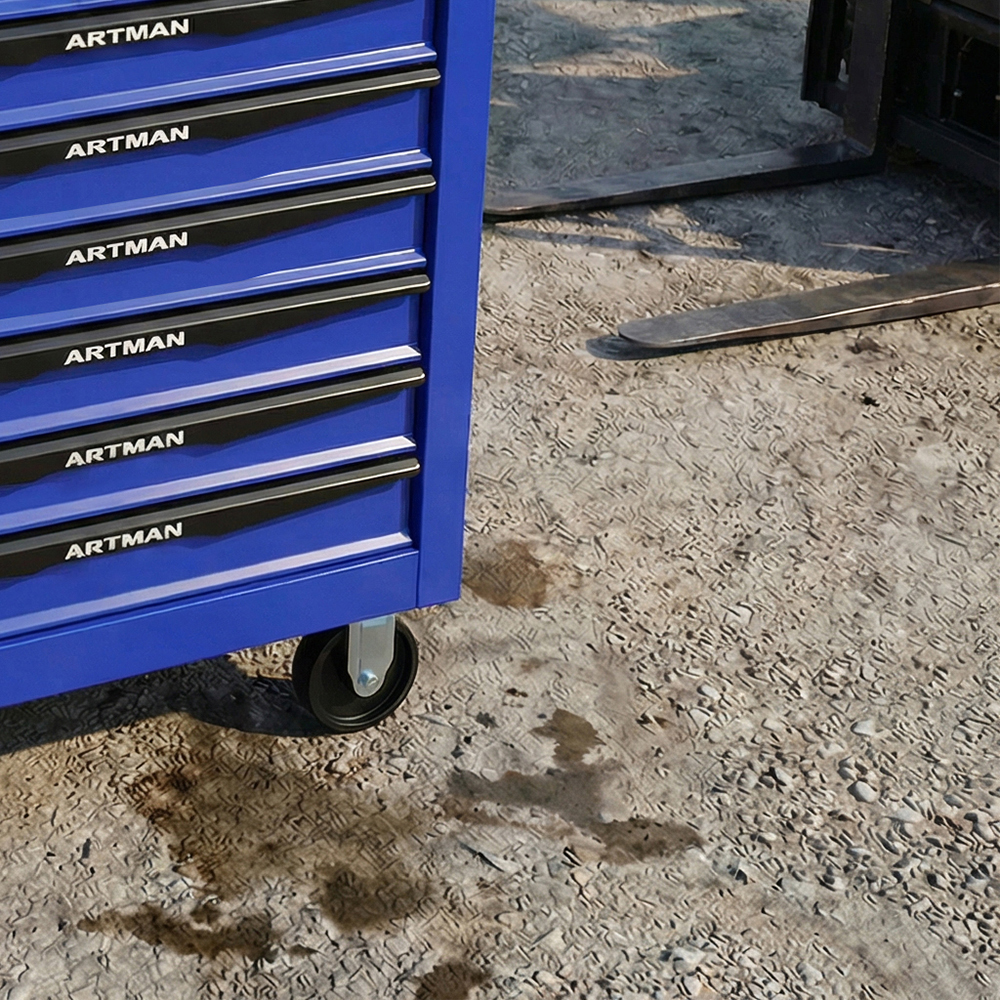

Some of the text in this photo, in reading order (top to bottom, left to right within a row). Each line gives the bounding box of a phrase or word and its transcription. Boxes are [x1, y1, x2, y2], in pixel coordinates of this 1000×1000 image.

[65, 18, 188, 51] ARTMAN
[65, 125, 188, 160] ARTMAN
[65, 231, 187, 266] ARTMAN
[64, 331, 185, 366] ARTMAN
[65, 430, 183, 468] ARTMAN
[64, 521, 183, 561] ARTMAN
